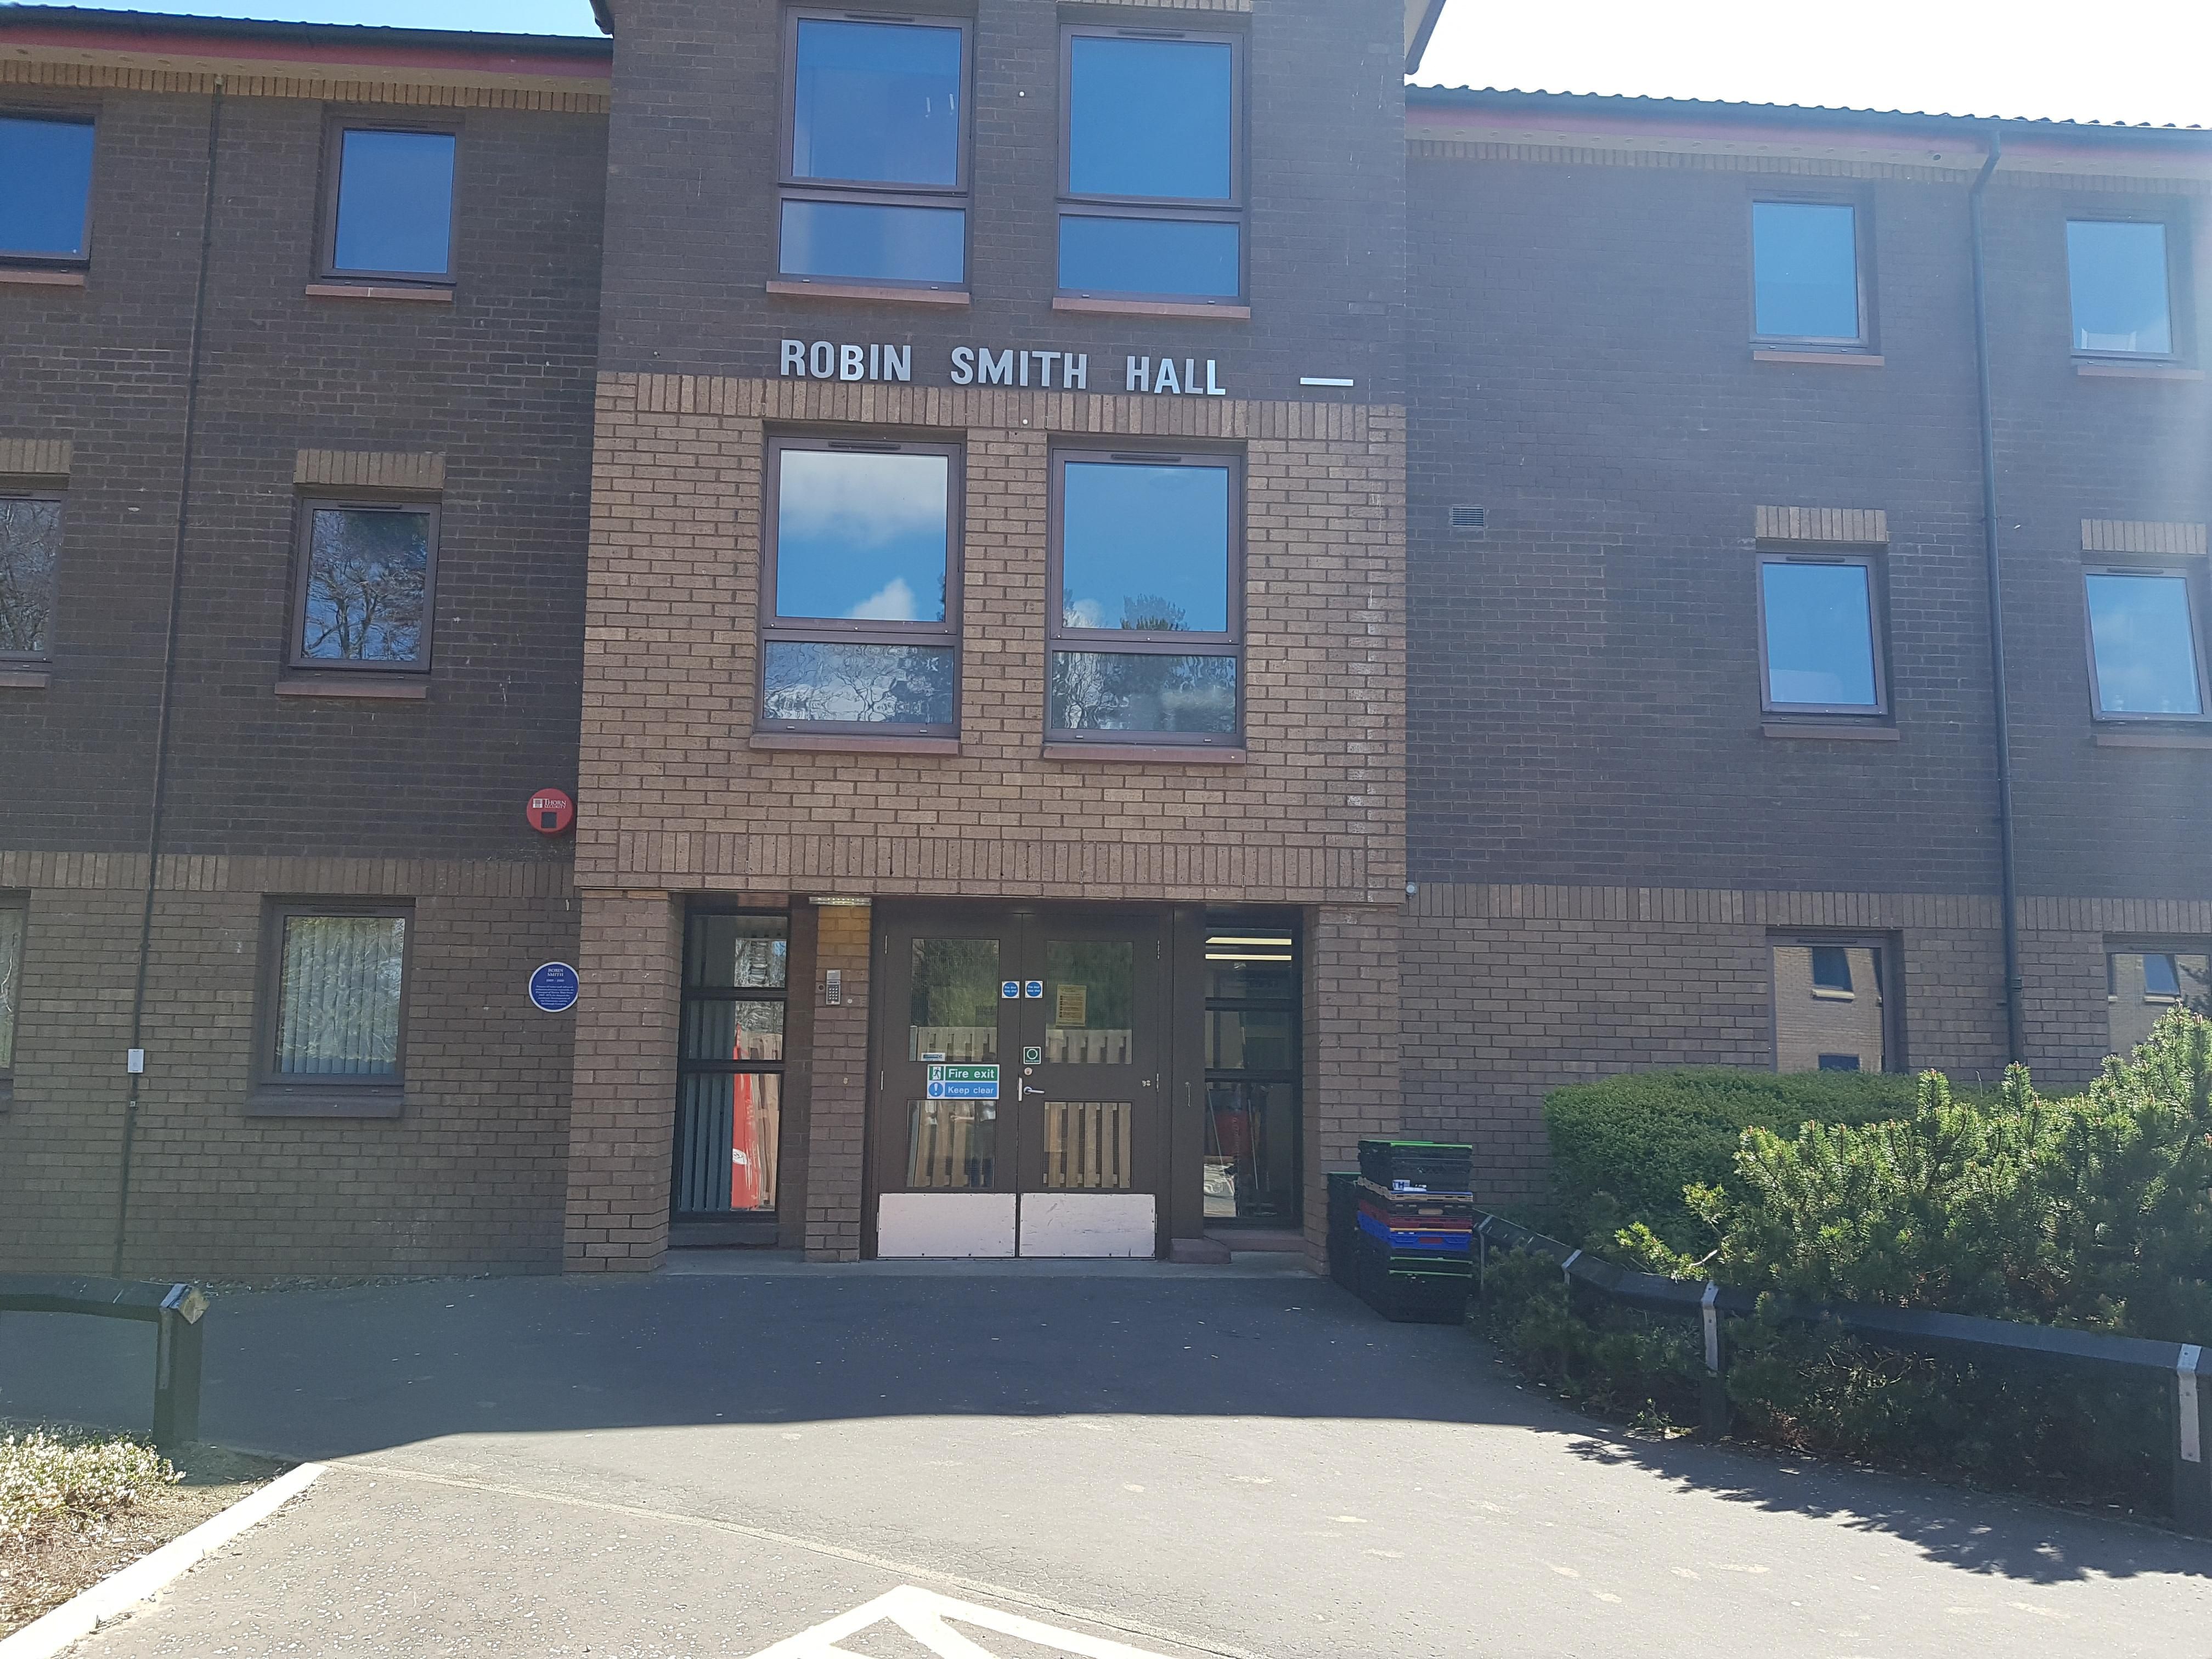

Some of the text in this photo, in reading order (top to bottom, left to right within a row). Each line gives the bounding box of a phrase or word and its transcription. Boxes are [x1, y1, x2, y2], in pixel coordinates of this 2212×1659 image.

[780, 338, 1226, 396] ROBIN SMITH HALL
[948, 1068, 995, 1079] Fire exit
[948, 1086, 970, 1095] Keep
